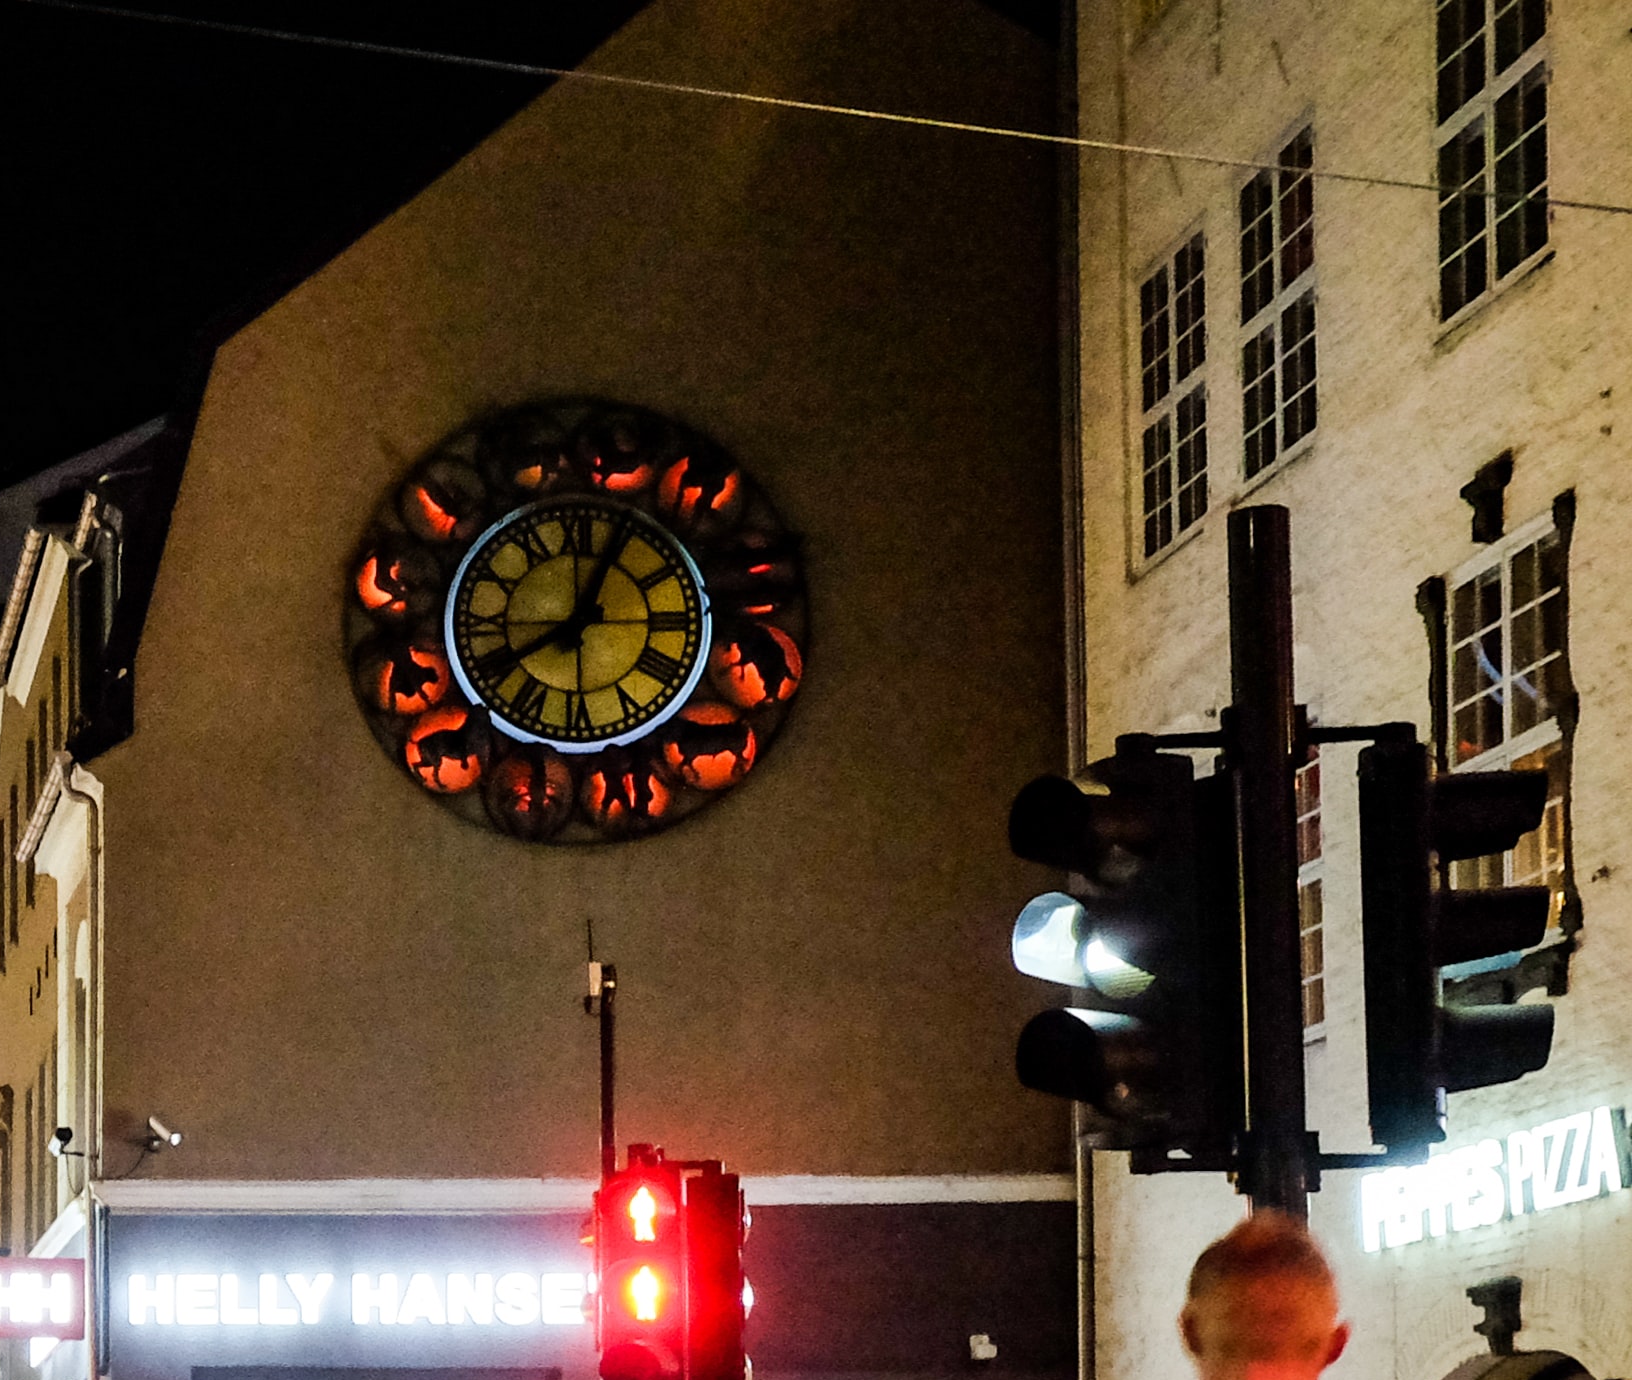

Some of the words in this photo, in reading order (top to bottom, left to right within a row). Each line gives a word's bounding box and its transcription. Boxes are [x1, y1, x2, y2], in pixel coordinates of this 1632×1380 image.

[1360, 1138, 1505, 1252] PEPPES
[1507, 1105, 1622, 1217] PIZZA
[128, 1273, 334, 1325] HELLY
[350, 1273, 595, 1325] HANSE
